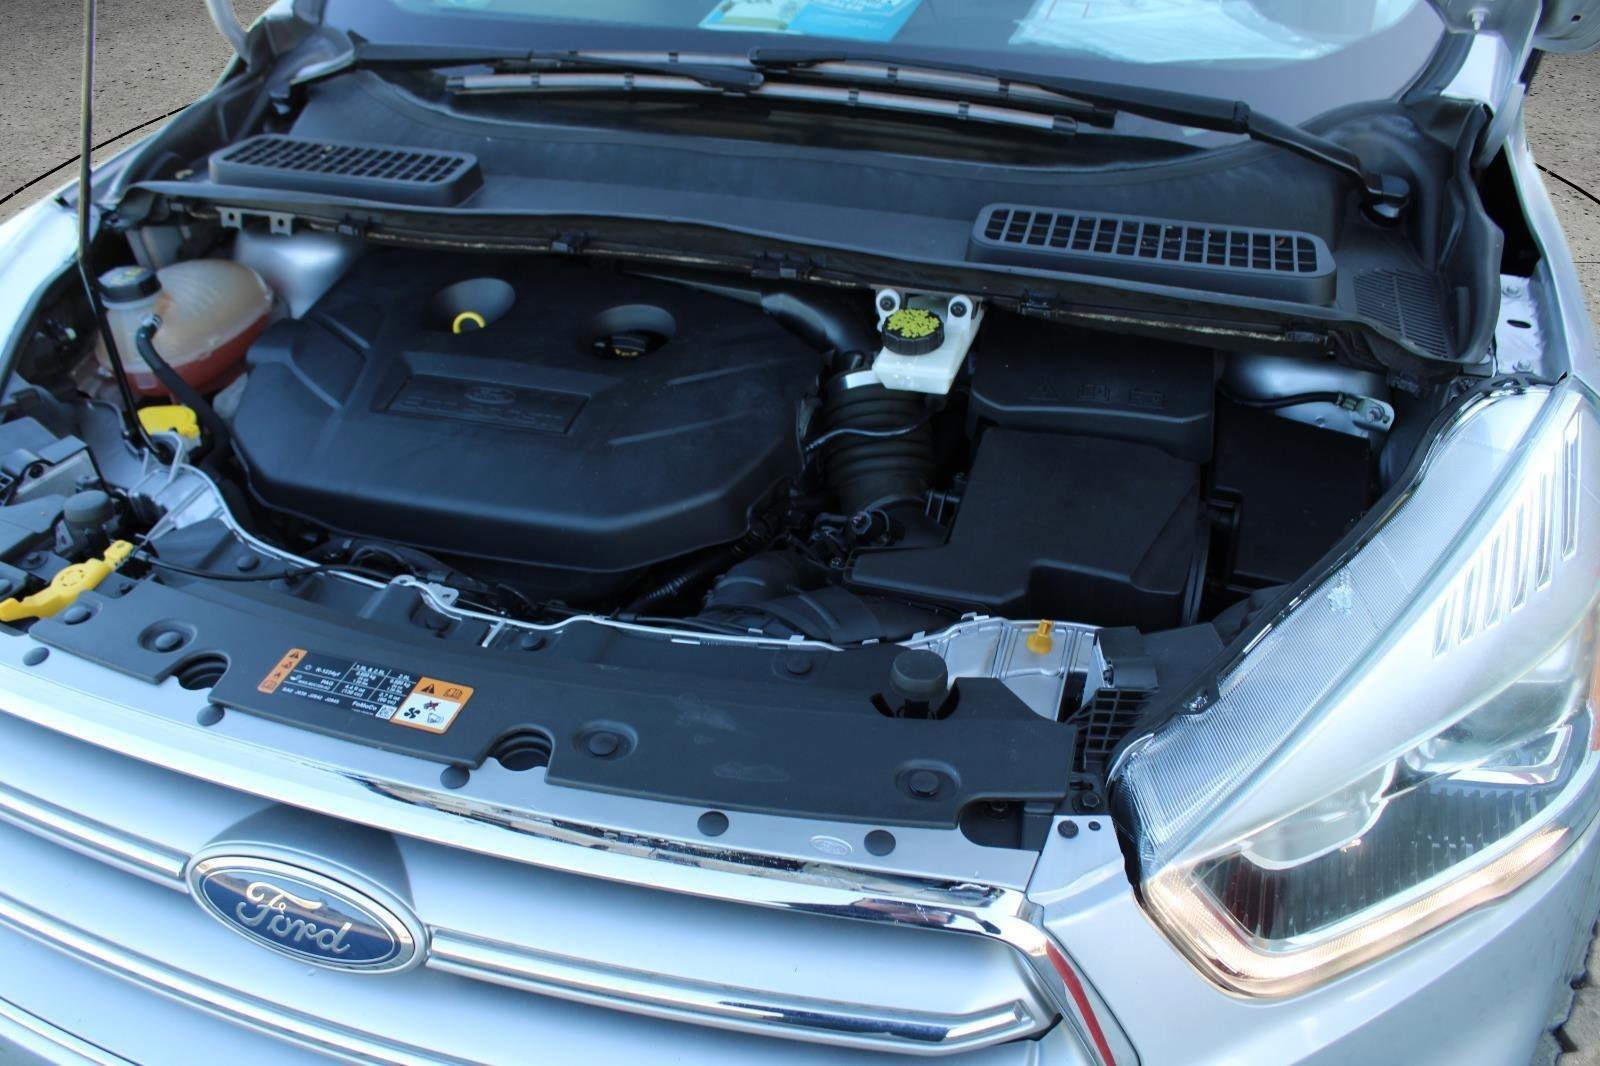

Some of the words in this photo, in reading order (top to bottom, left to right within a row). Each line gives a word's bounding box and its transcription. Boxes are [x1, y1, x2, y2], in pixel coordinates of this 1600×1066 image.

[320, 678, 335, 687] PAG
[352, 700, 378, 711] FoMoCo
[235, 881, 352, 954] Ford
